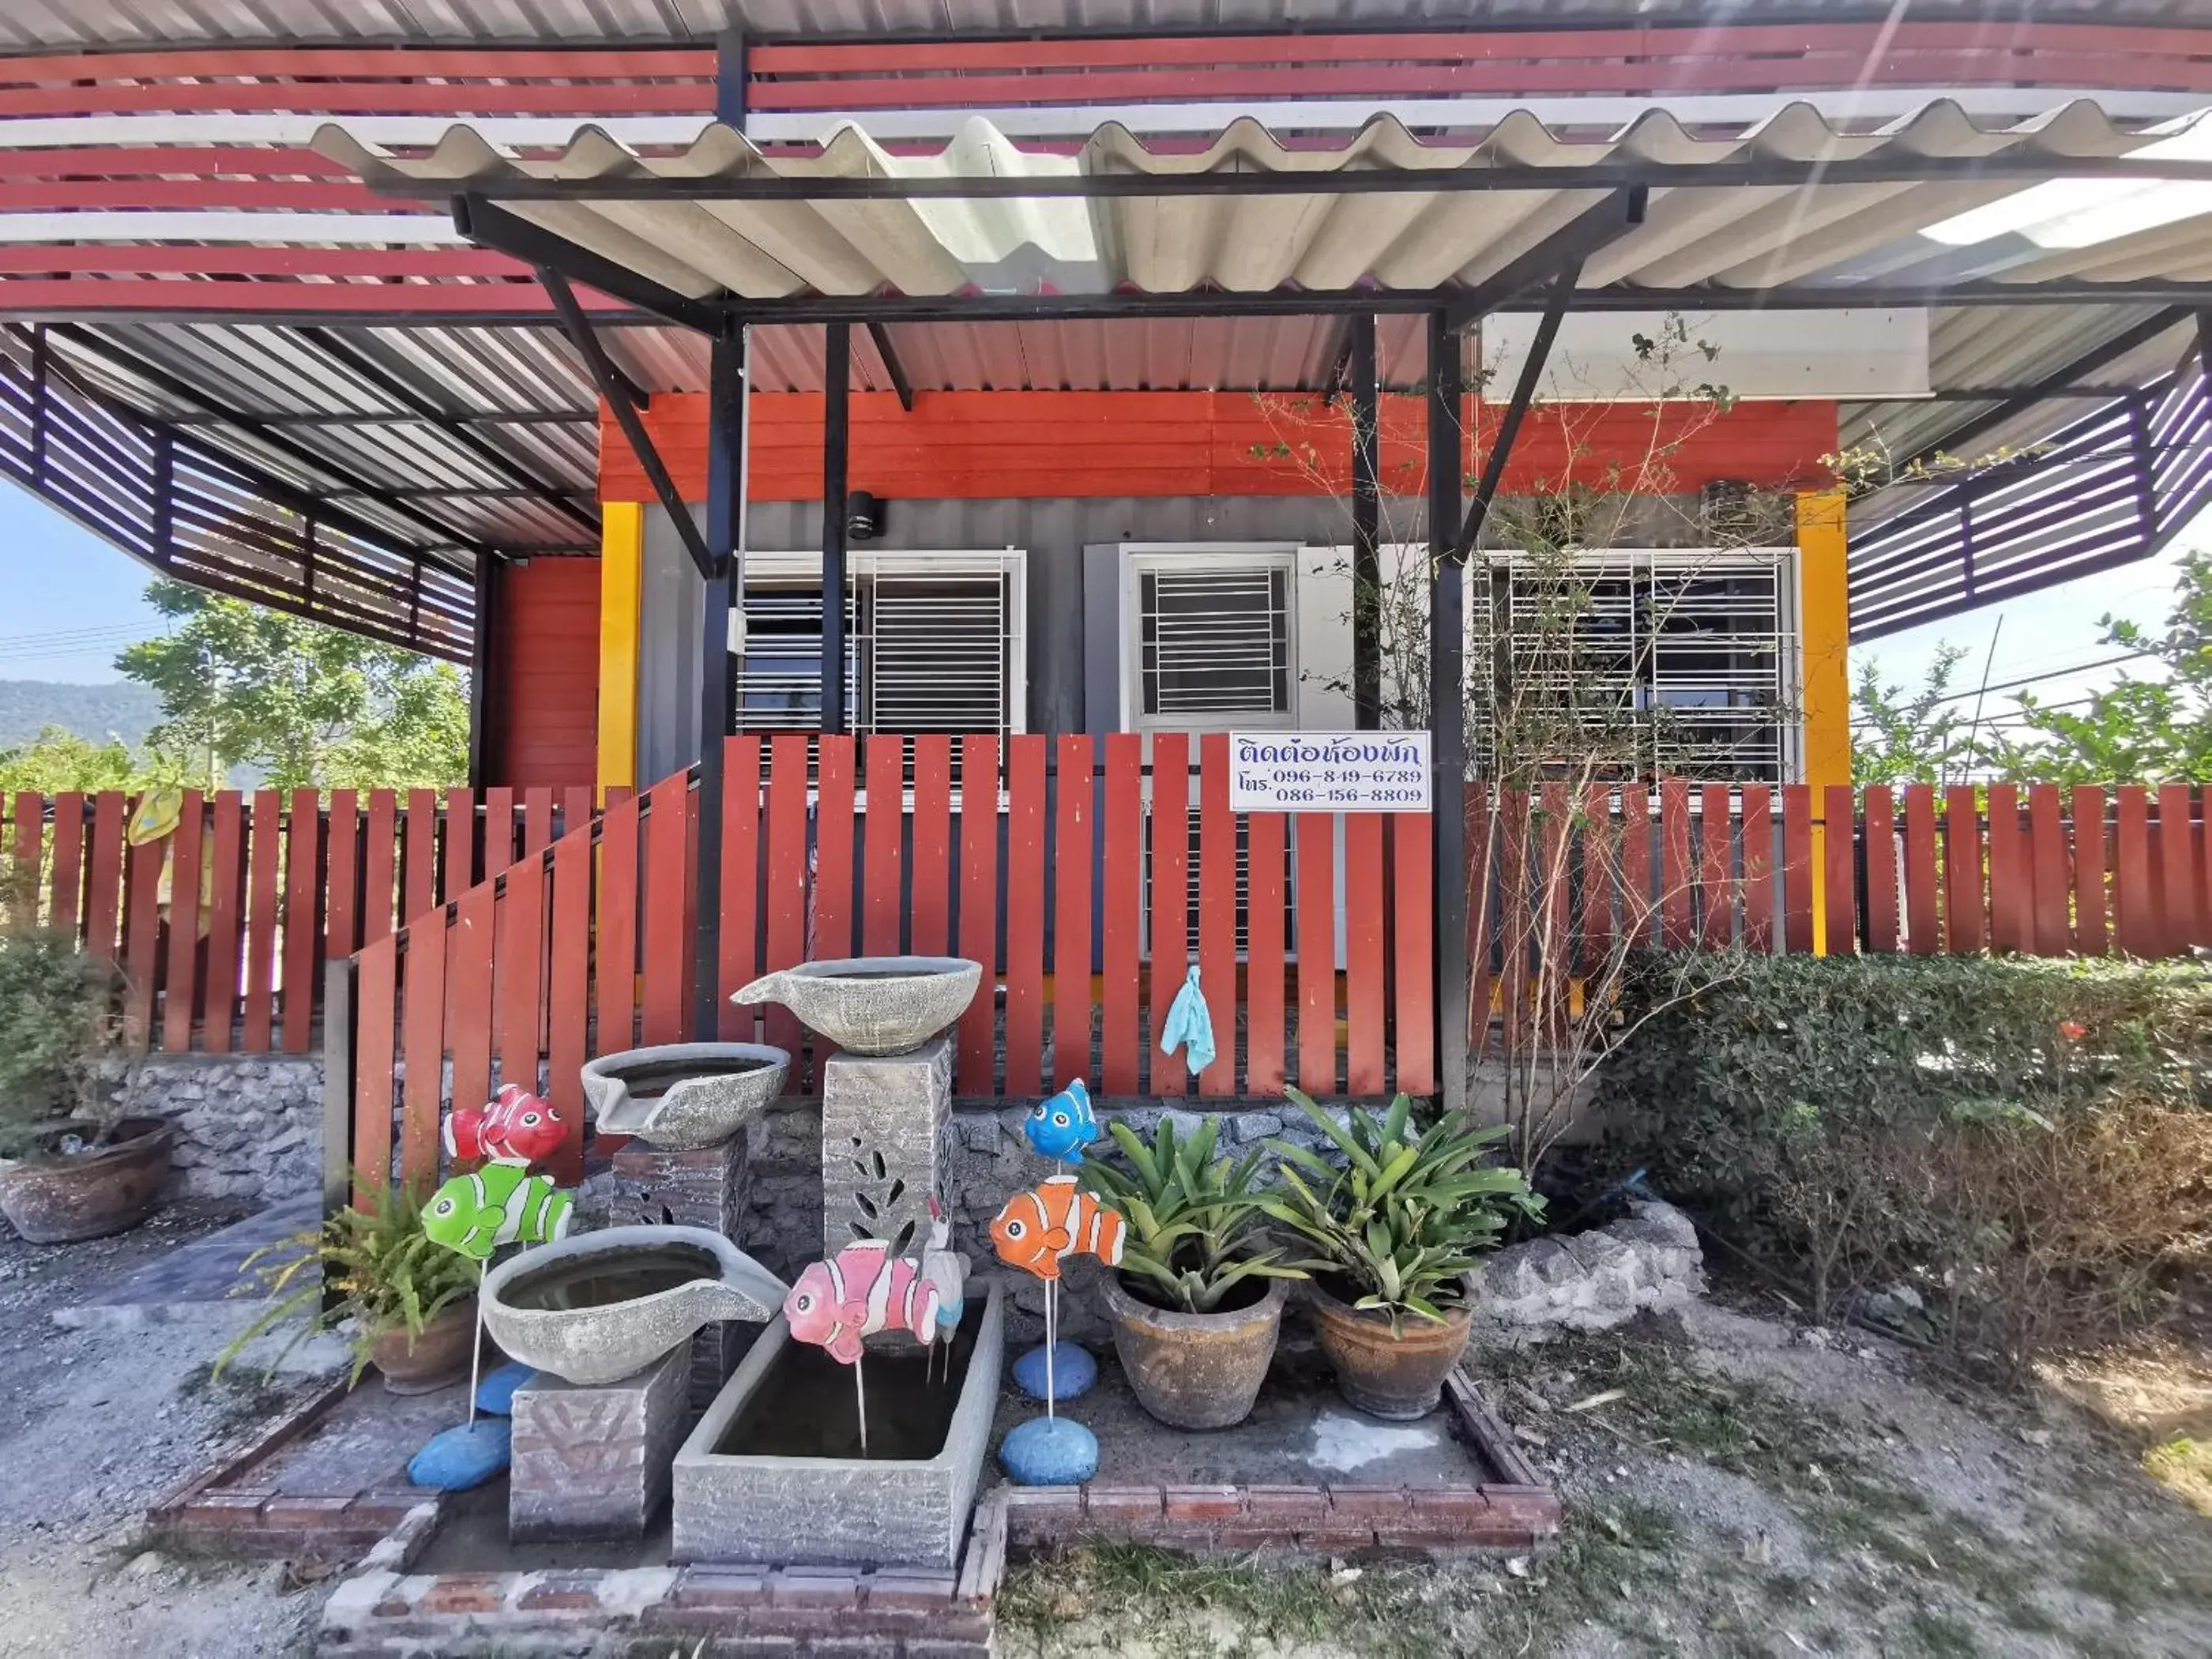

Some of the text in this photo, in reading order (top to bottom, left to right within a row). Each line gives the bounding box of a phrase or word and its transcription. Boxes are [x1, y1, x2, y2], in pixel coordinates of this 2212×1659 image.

[1238, 737, 1423, 767] ติดต่อห้องพัก
[1238, 769, 1422, 791] โทร. 096-849-6789
[1276, 788, 1422, 802] 086-156-8809
